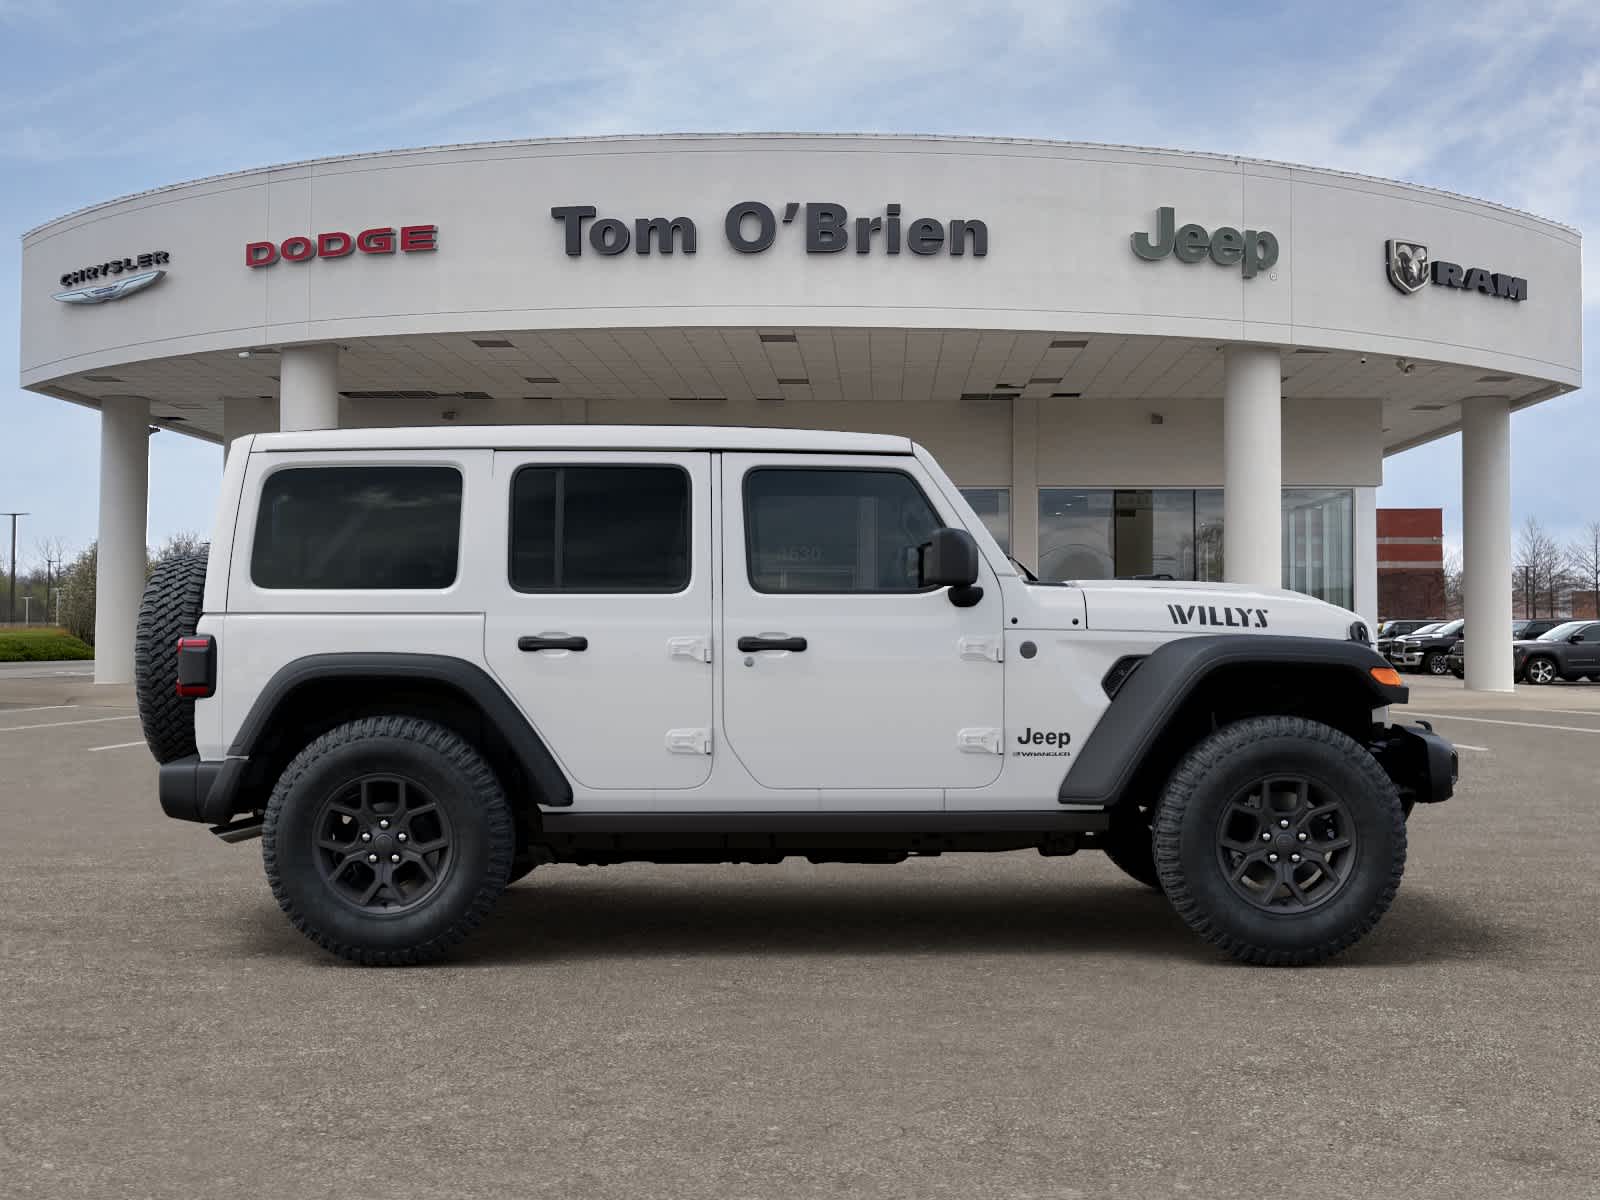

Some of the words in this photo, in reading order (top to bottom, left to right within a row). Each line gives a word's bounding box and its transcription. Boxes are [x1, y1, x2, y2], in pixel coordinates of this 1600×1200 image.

[245, 224, 438, 270] DODGE
[551, 205, 697, 257] Tom
[724, 201, 988, 257] O'Brien
[1130, 206, 1279, 280] Jeep
[60, 250, 170, 287] CHRYSLER
[1430, 260, 1528, 302] RAM
[1167, 604, 1268, 628] WILLYS
[1017, 727, 1071, 748] Jeep
